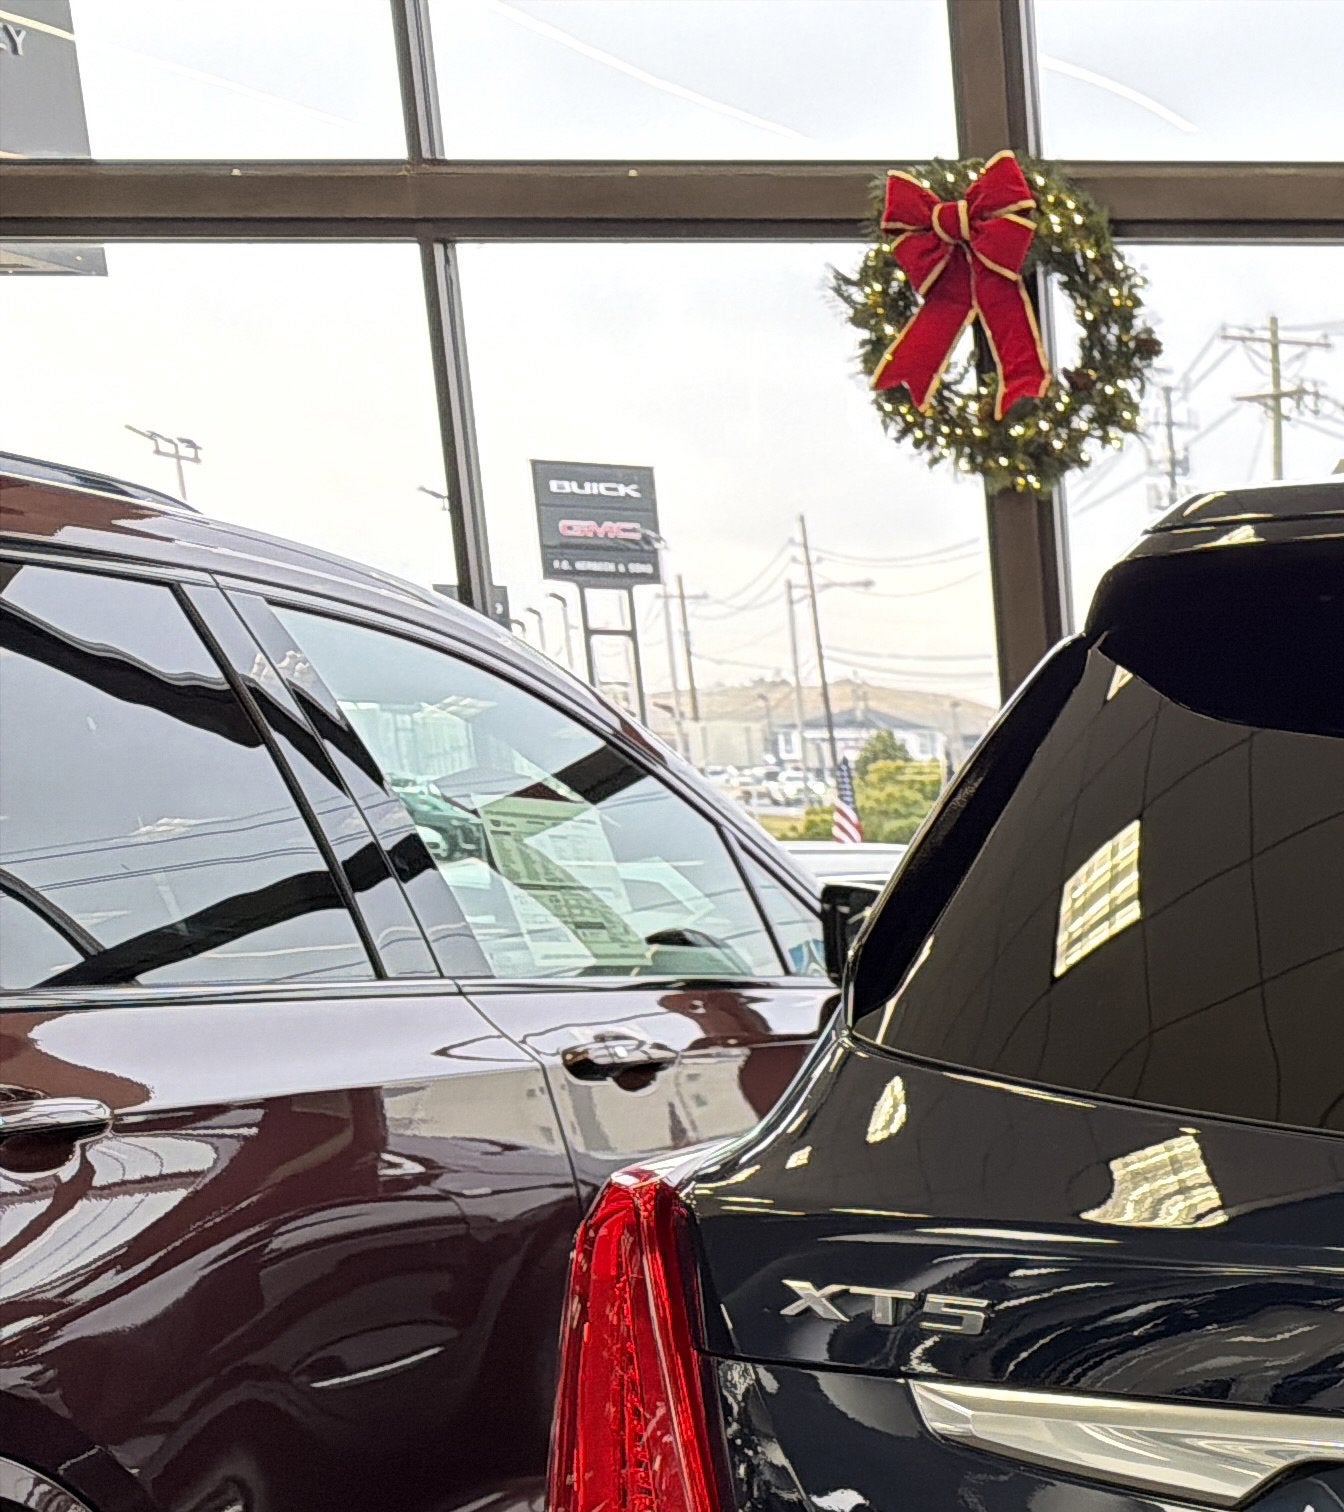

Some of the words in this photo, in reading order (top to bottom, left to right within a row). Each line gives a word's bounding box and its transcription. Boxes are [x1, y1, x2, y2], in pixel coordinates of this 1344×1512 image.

[548, 479, 642, 498] BUICK
[558, 519, 642, 541] GMC
[779, 1278, 993, 1336] XT5
